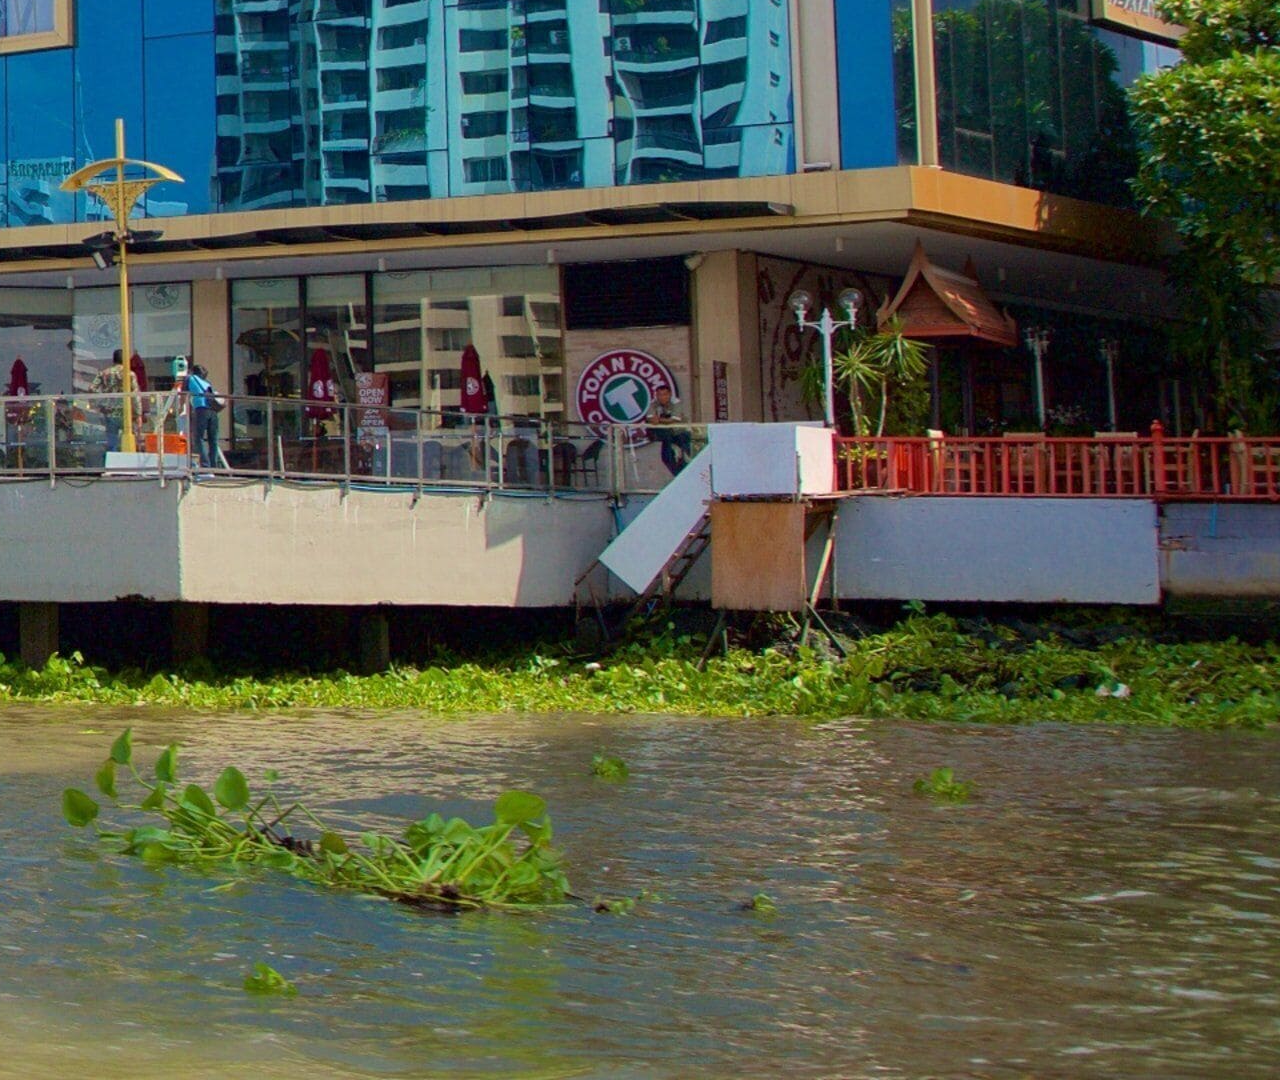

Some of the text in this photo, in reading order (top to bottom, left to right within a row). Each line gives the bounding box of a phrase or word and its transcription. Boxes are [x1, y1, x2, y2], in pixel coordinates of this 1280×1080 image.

[582, 364, 611, 404] TOM
[611, 356, 625, 372] N
[630, 356, 666, 404] TOM
